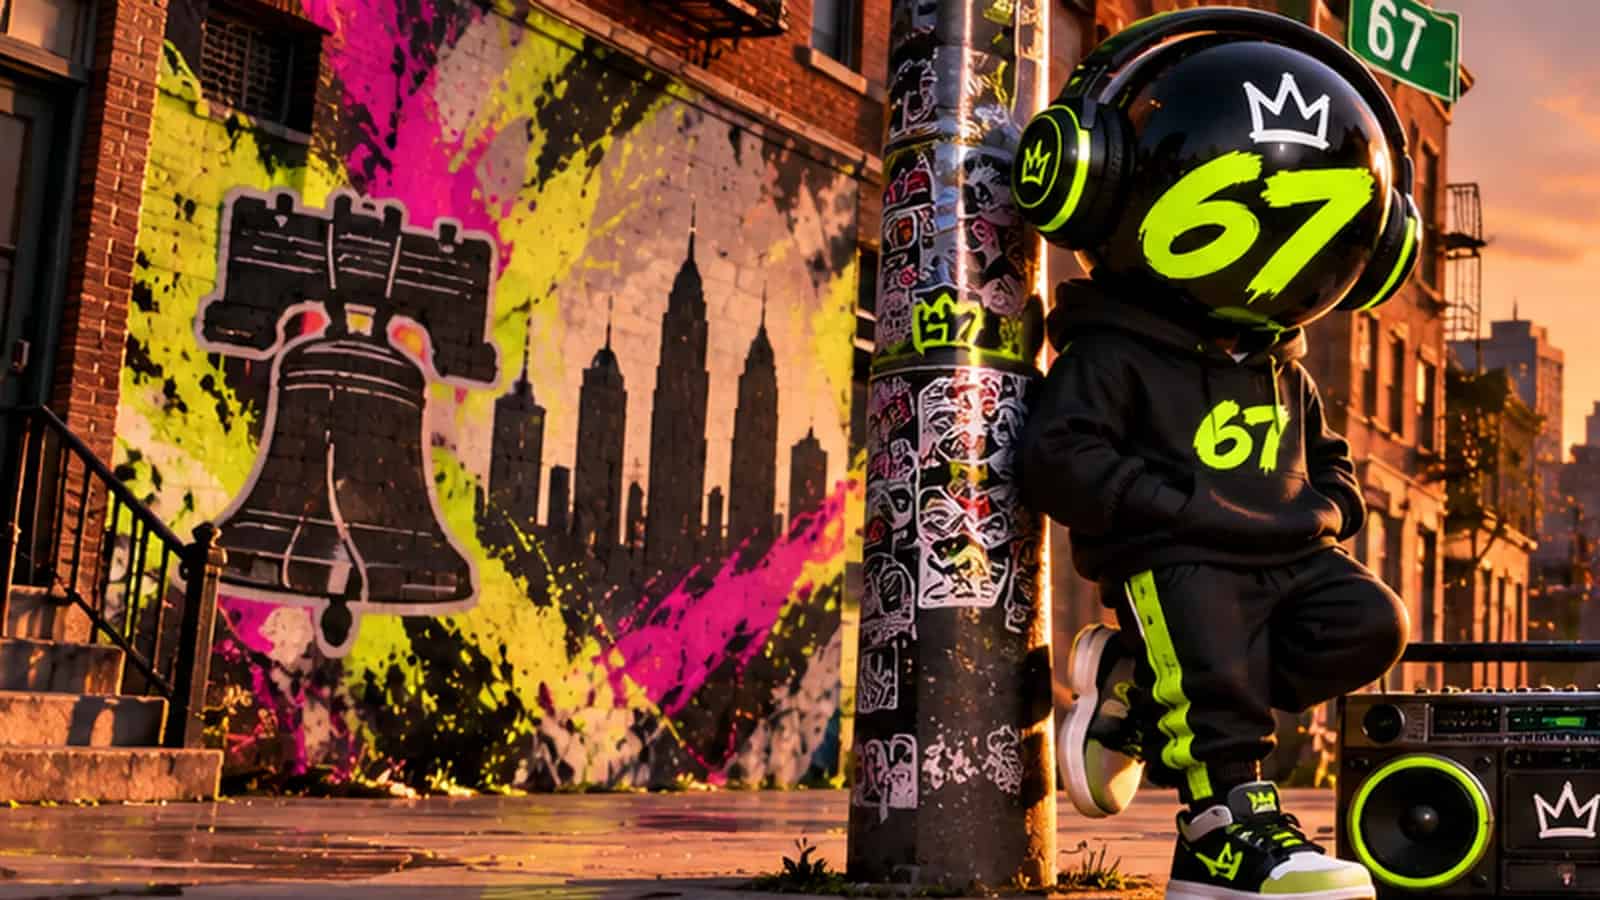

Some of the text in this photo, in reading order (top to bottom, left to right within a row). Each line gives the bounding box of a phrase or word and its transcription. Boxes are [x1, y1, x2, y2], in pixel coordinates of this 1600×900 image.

[1368, 0, 1427, 71] 67
[1139, 151, 1375, 304] 67
[1193, 400, 1290, 475] 67
